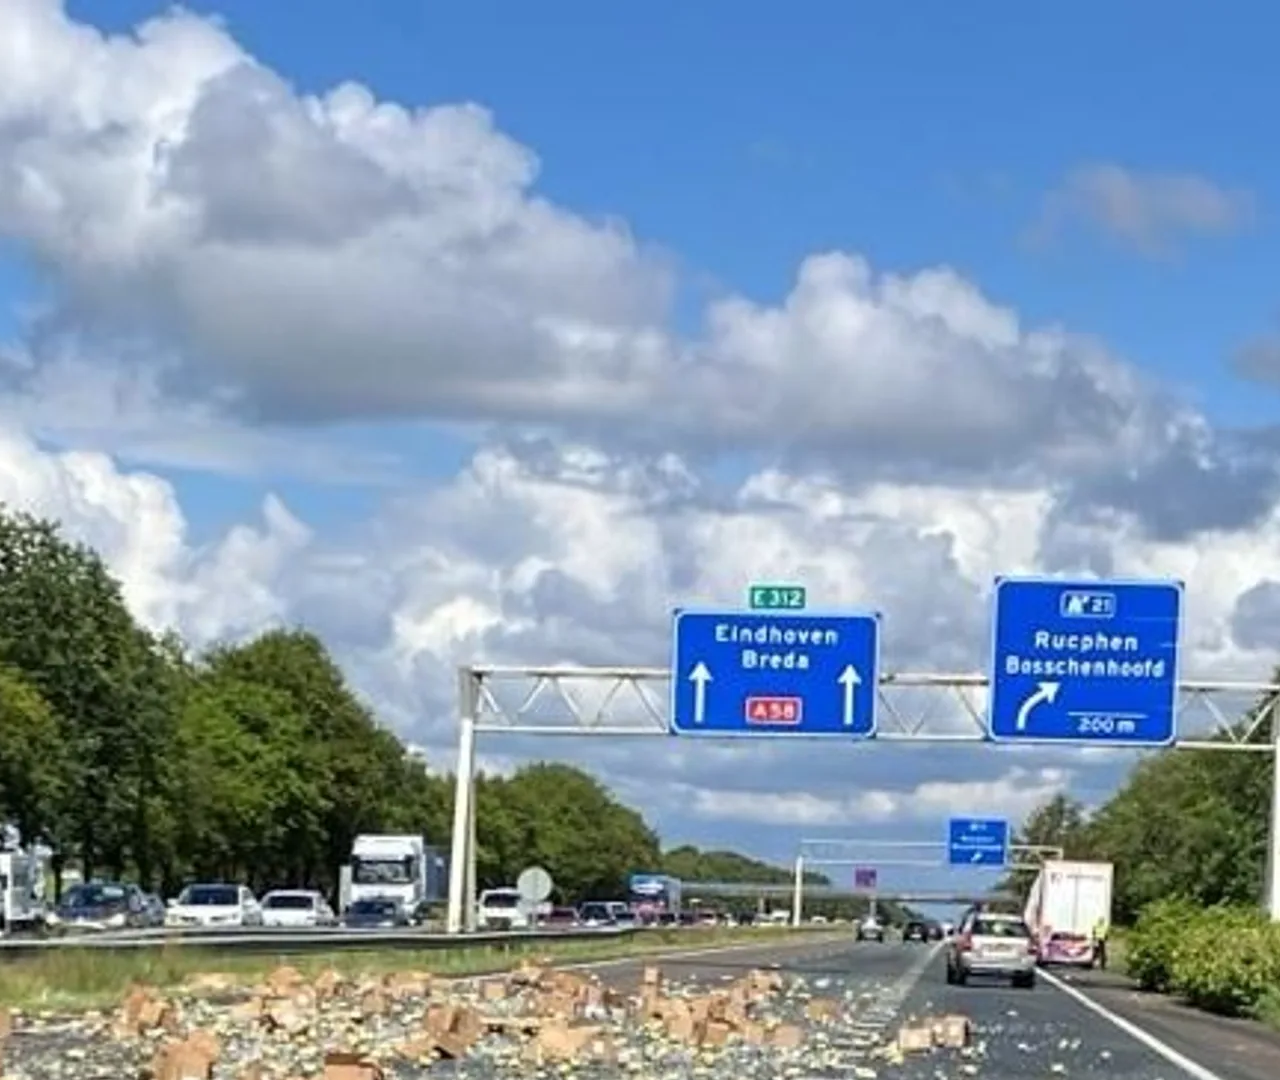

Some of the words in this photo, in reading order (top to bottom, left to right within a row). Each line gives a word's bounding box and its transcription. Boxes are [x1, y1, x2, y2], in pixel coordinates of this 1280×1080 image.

[753, 590, 764, 606] E
[1091, 599, 1113, 613] 21
[714, 623, 839, 646] Eindhoven
[1034, 630, 1139, 654] Rucphen
[741, 648, 810, 670] Breda
[1005, 655, 1166, 679] Bosschenhoofd
[1077, 717, 1114, 734] 200
[1116, 720, 1136, 734] m
